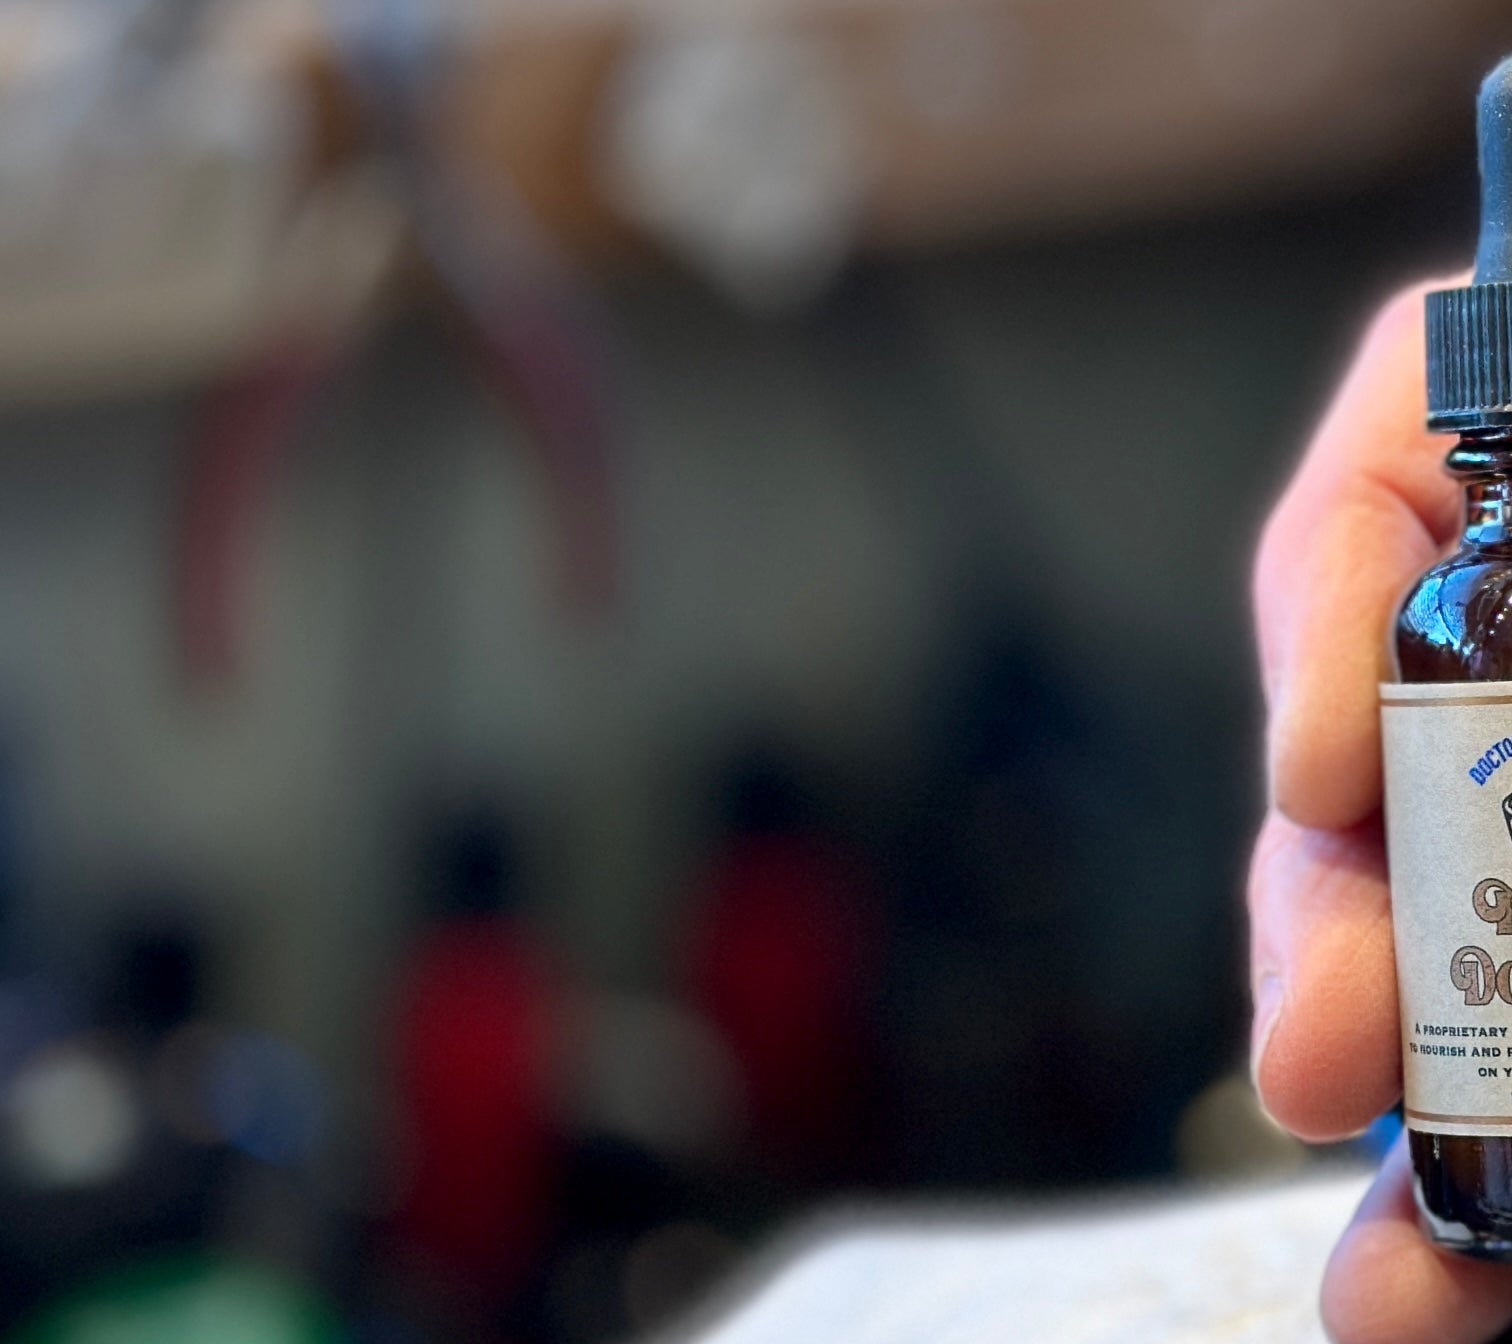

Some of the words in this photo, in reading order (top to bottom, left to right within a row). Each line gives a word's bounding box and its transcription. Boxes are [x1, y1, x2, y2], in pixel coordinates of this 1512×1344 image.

[1423, 1025, 1508, 1038] PROPRIETARY
[1420, 1044, 1467, 1057] NOURISH
[1471, 1047, 1502, 1057] AND
[1478, 1067, 1498, 1078] ON
